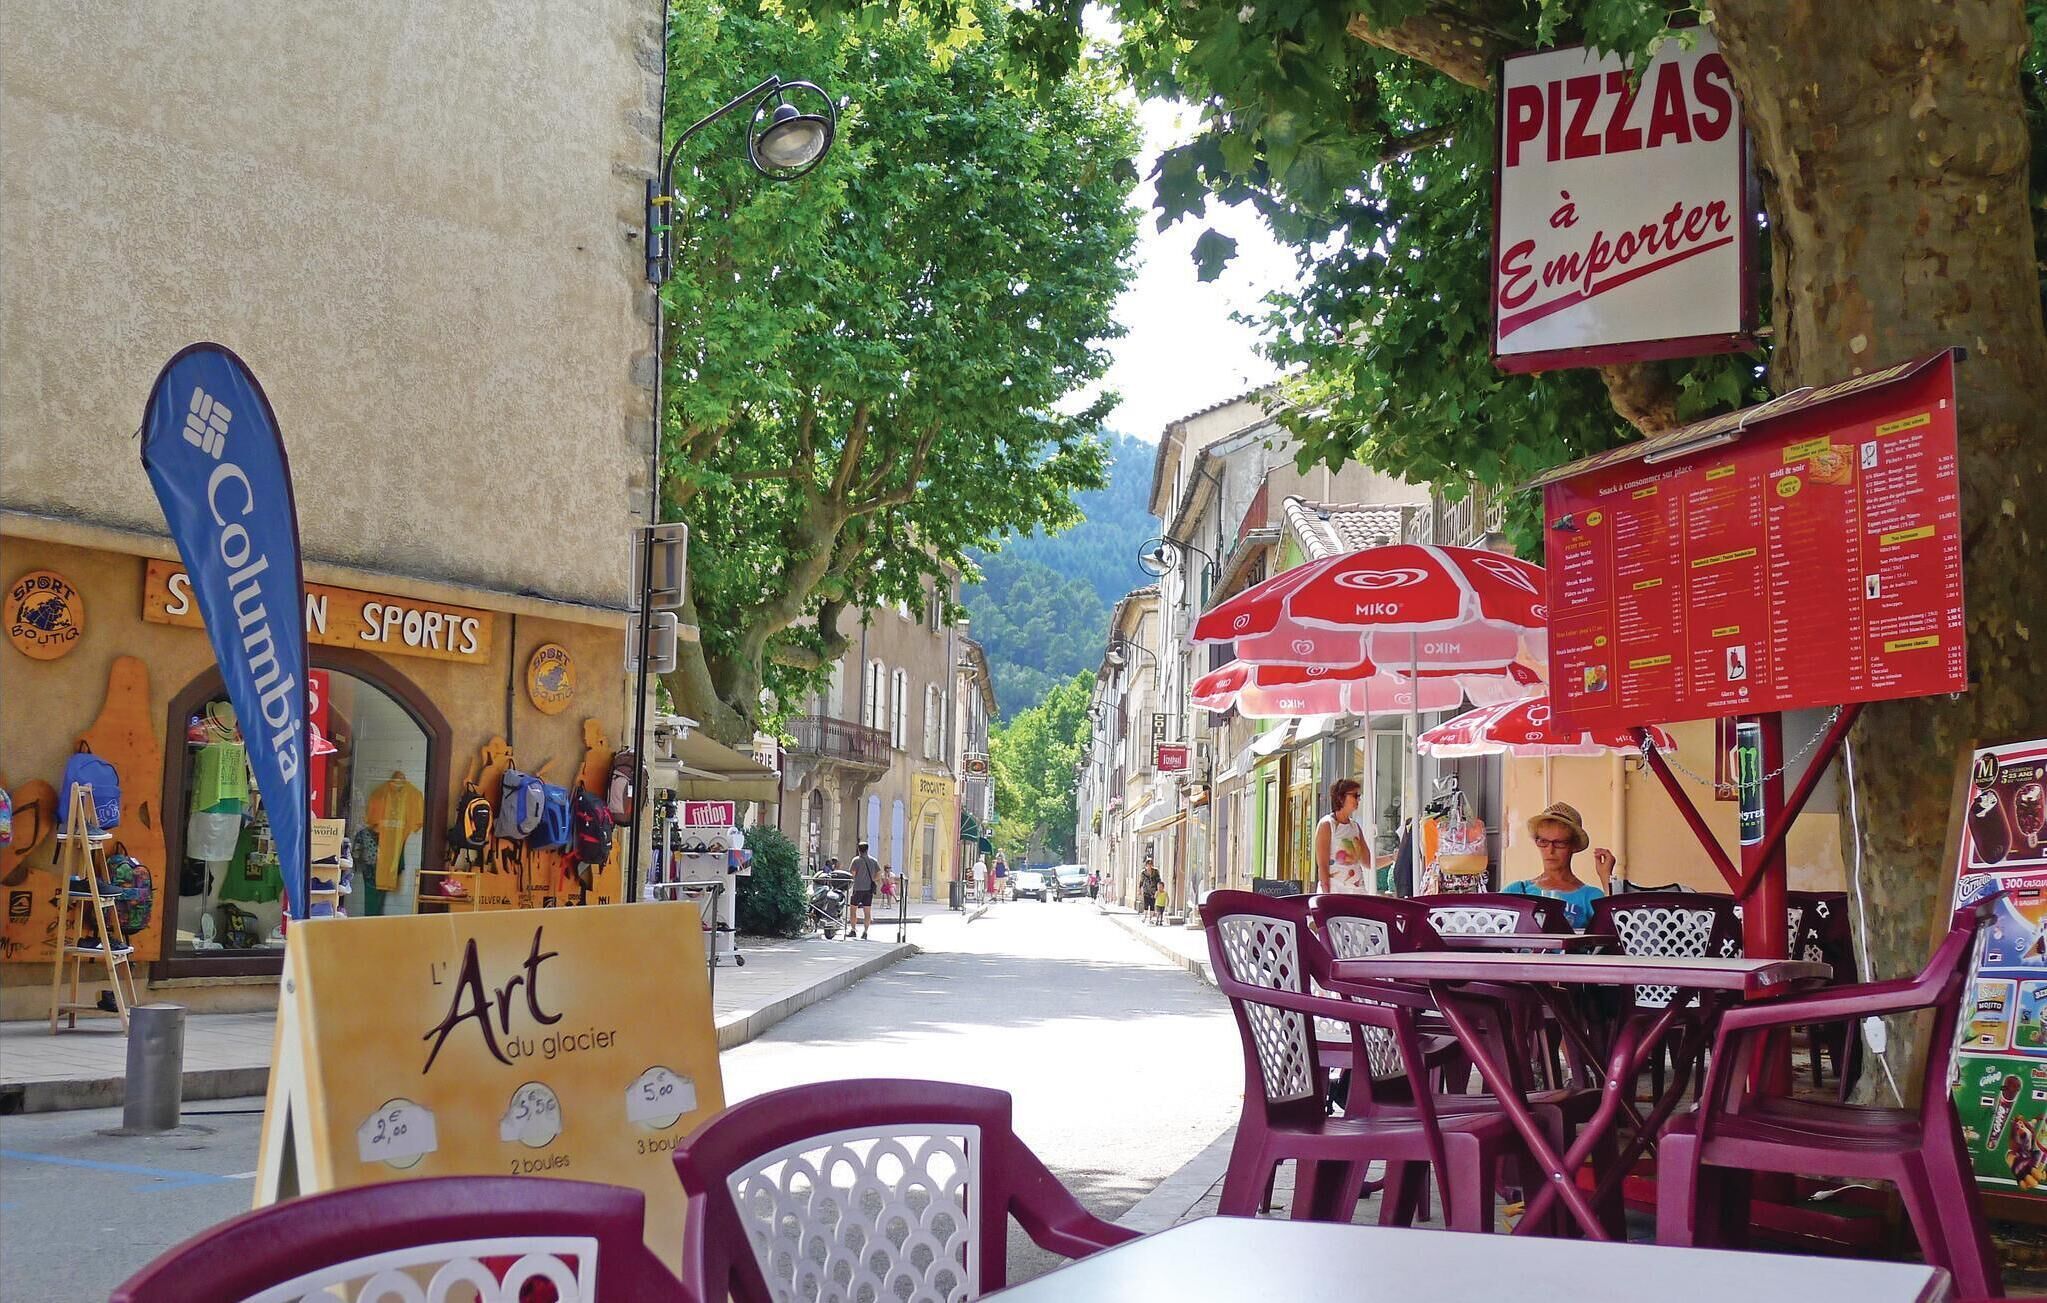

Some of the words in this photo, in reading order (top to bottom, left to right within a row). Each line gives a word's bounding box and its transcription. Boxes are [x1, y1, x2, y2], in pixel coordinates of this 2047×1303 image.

[1506, 52, 1733, 168] PIZZAS
[1550, 190, 1579, 229] à
[1500, 199, 1731, 310] Emporter
[1599, 484, 1618, 497] Snack
[1624, 474, 1661, 489] consommer
[1661, 470, 1673, 481] sur
[1674, 464, 1693, 478] place
[1769, 467, 1784, 479] midi
[1792, 463, 1806, 474] soir
[13, 576, 76, 602] SPORT
[1355, 603, 1399, 616] MIKO
[12, 623, 80, 645] BOUTIQ
[207, 461, 302, 786] Columbia
[360, 602, 480, 655] SPORTS
[533, 647, 572, 672] SPORT
[919, 778, 946, 797] BROCANTE
[692, 803, 727, 828] fitflop
[313, 827, 339, 836] world
[2005, 877, 2023, 889] 300
[422, 925, 563, 1076] Art
[507, 1035, 535, 1059] du
[541, 1027, 617, 1060] glacier
[637, 1139, 646, 1155] 3
[511, 1159, 520, 1175] 2
[523, 1153, 571, 1174] boules
